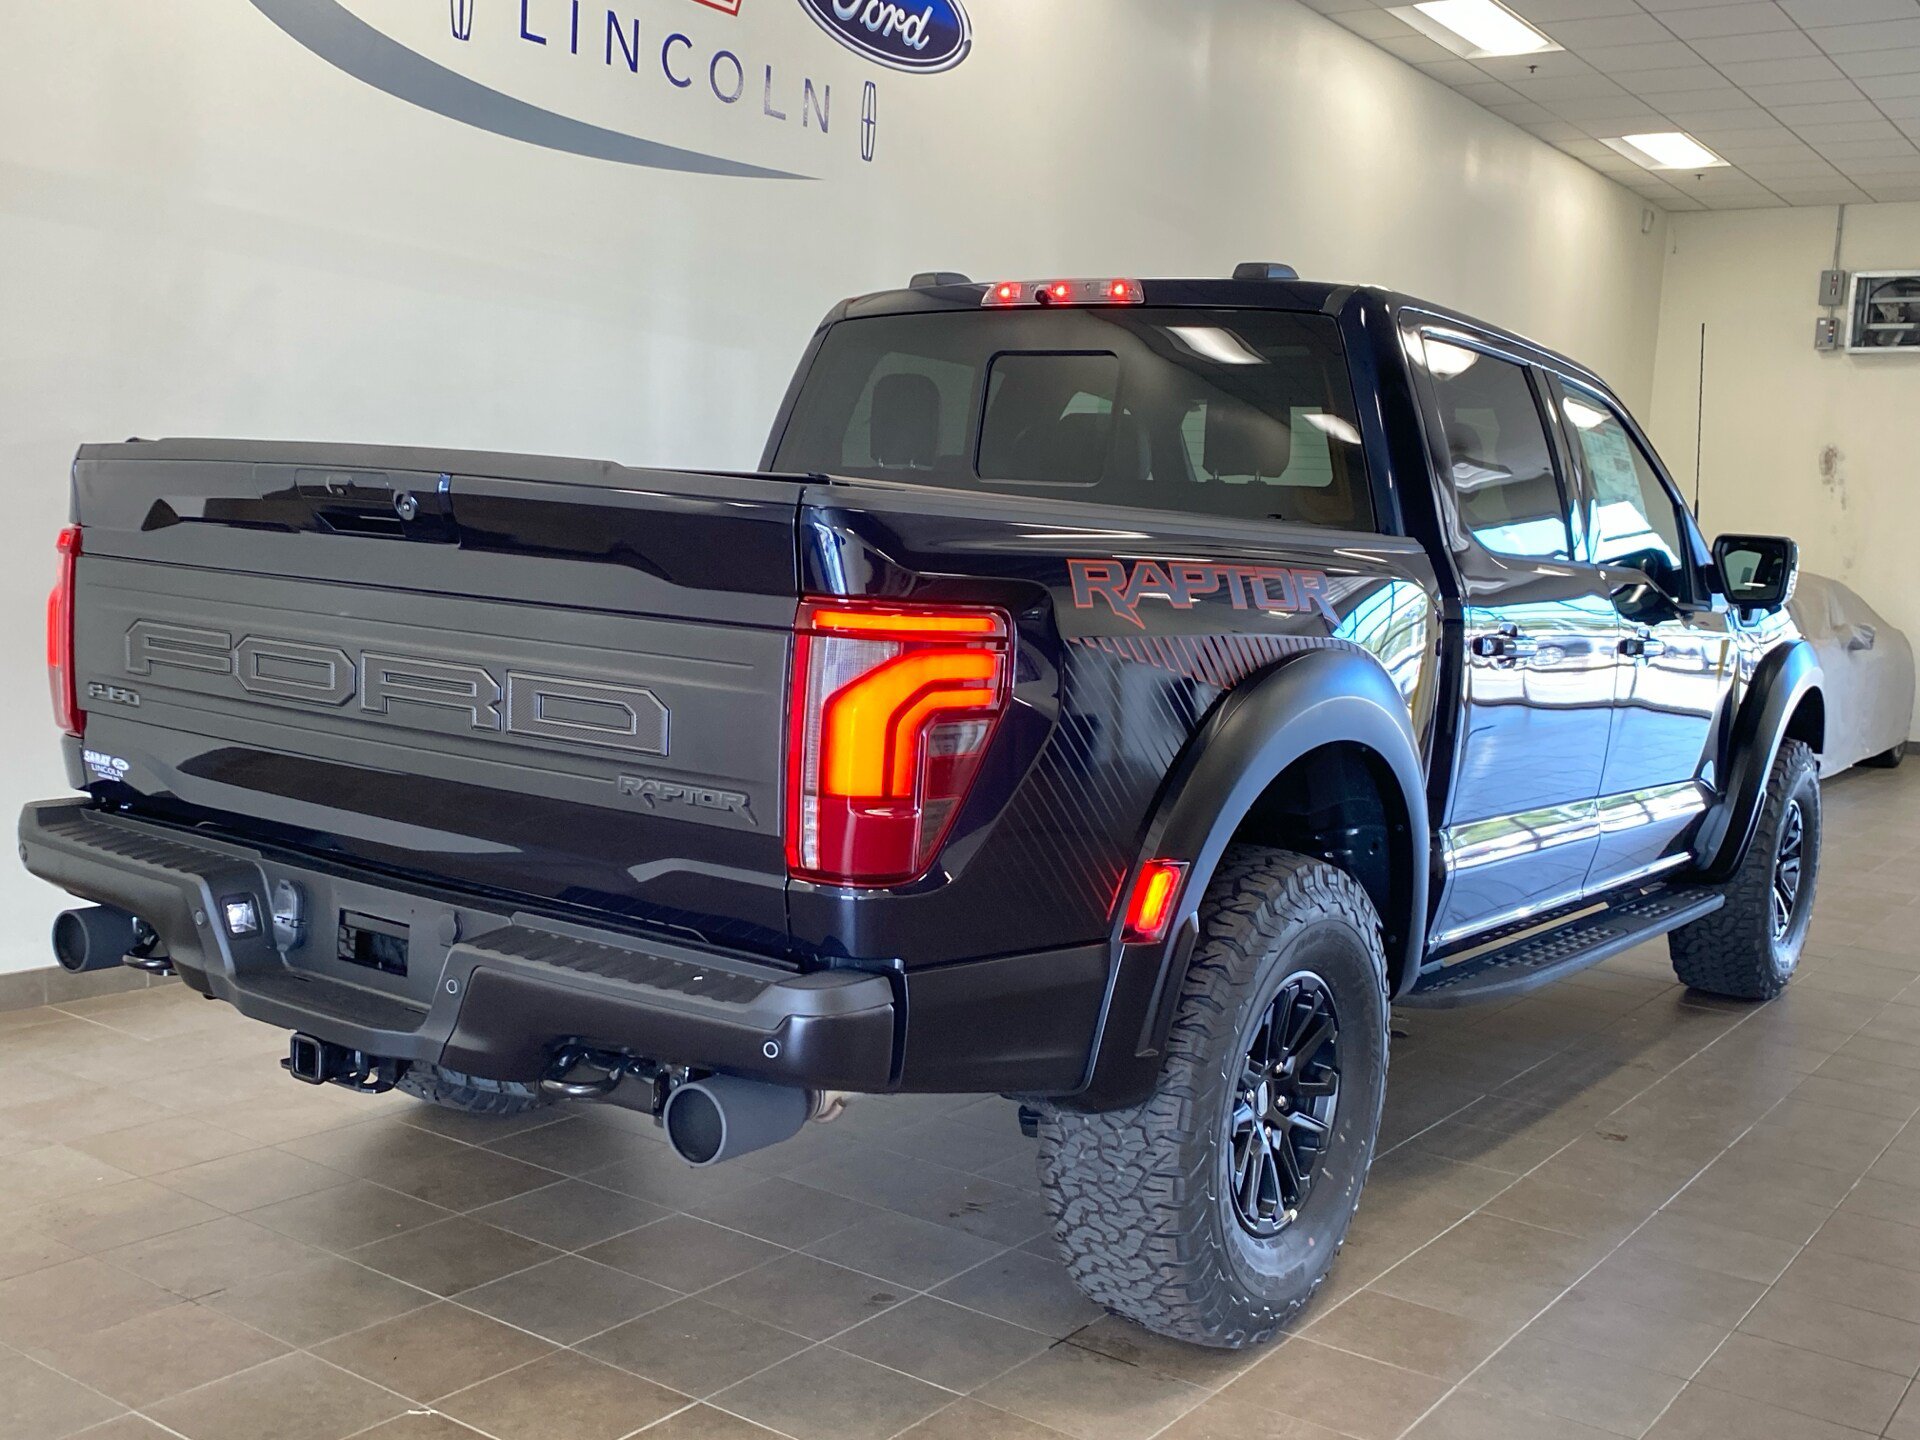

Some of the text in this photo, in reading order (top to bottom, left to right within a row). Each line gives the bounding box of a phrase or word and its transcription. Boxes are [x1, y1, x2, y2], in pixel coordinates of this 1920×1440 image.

[520, 0, 830, 133] LINCOLN
[1066, 558, 1345, 631] RAPTOR
[124, 617, 671, 757] FORD
[618, 774, 758, 826] RAPTOR
